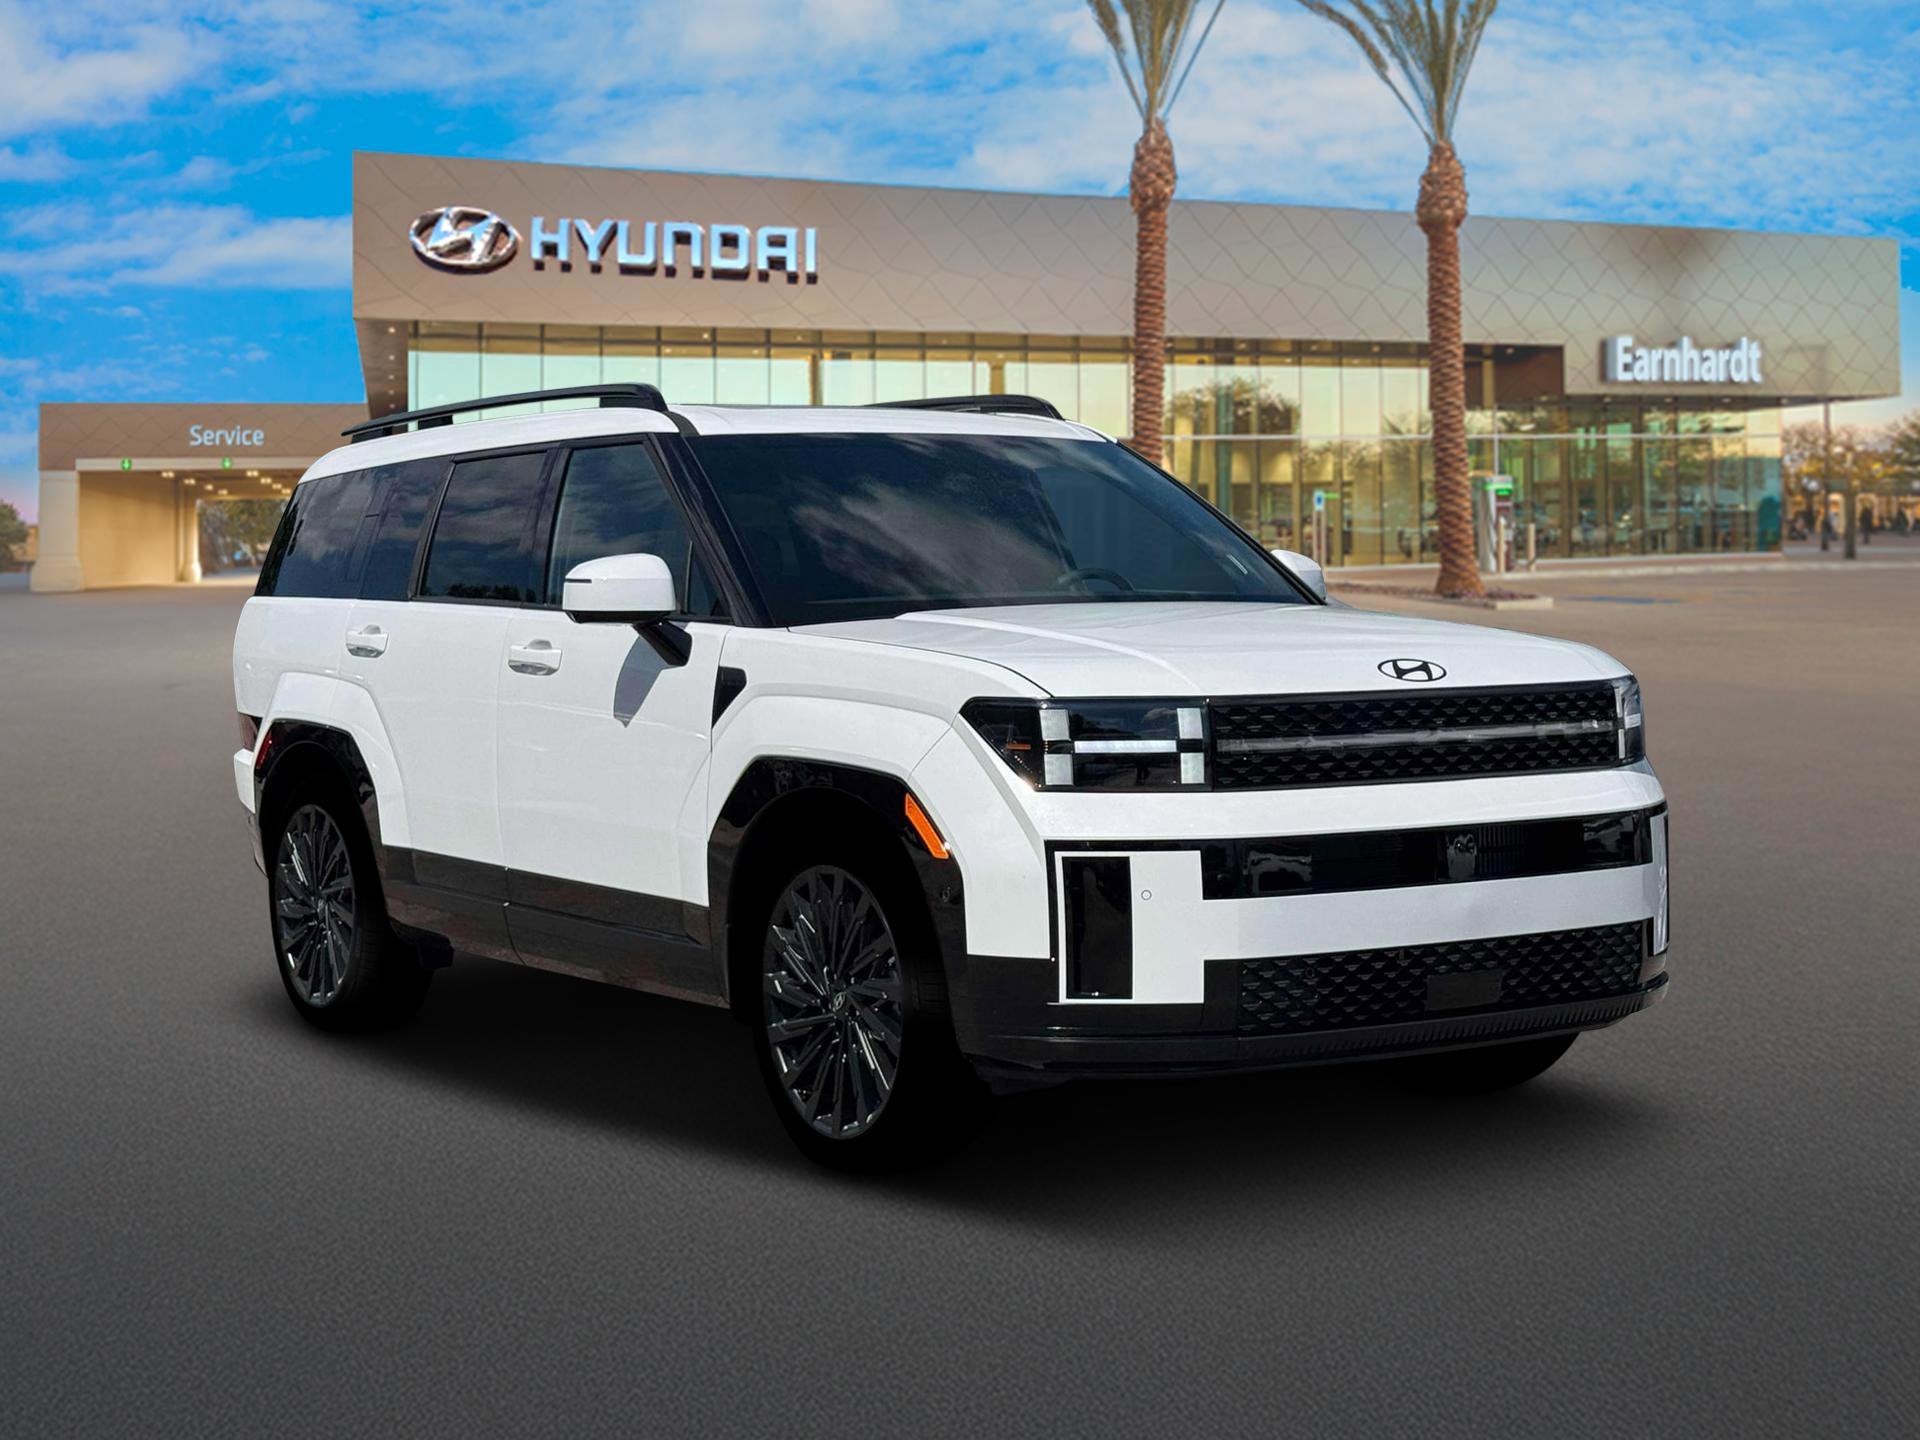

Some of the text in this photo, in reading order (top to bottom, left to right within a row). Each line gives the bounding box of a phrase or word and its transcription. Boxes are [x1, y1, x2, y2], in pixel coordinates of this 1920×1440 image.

[530, 216, 818, 284] HYUNDAI
[1606, 335, 1763, 383] Earnhardt
[189, 424, 265, 447] Service
